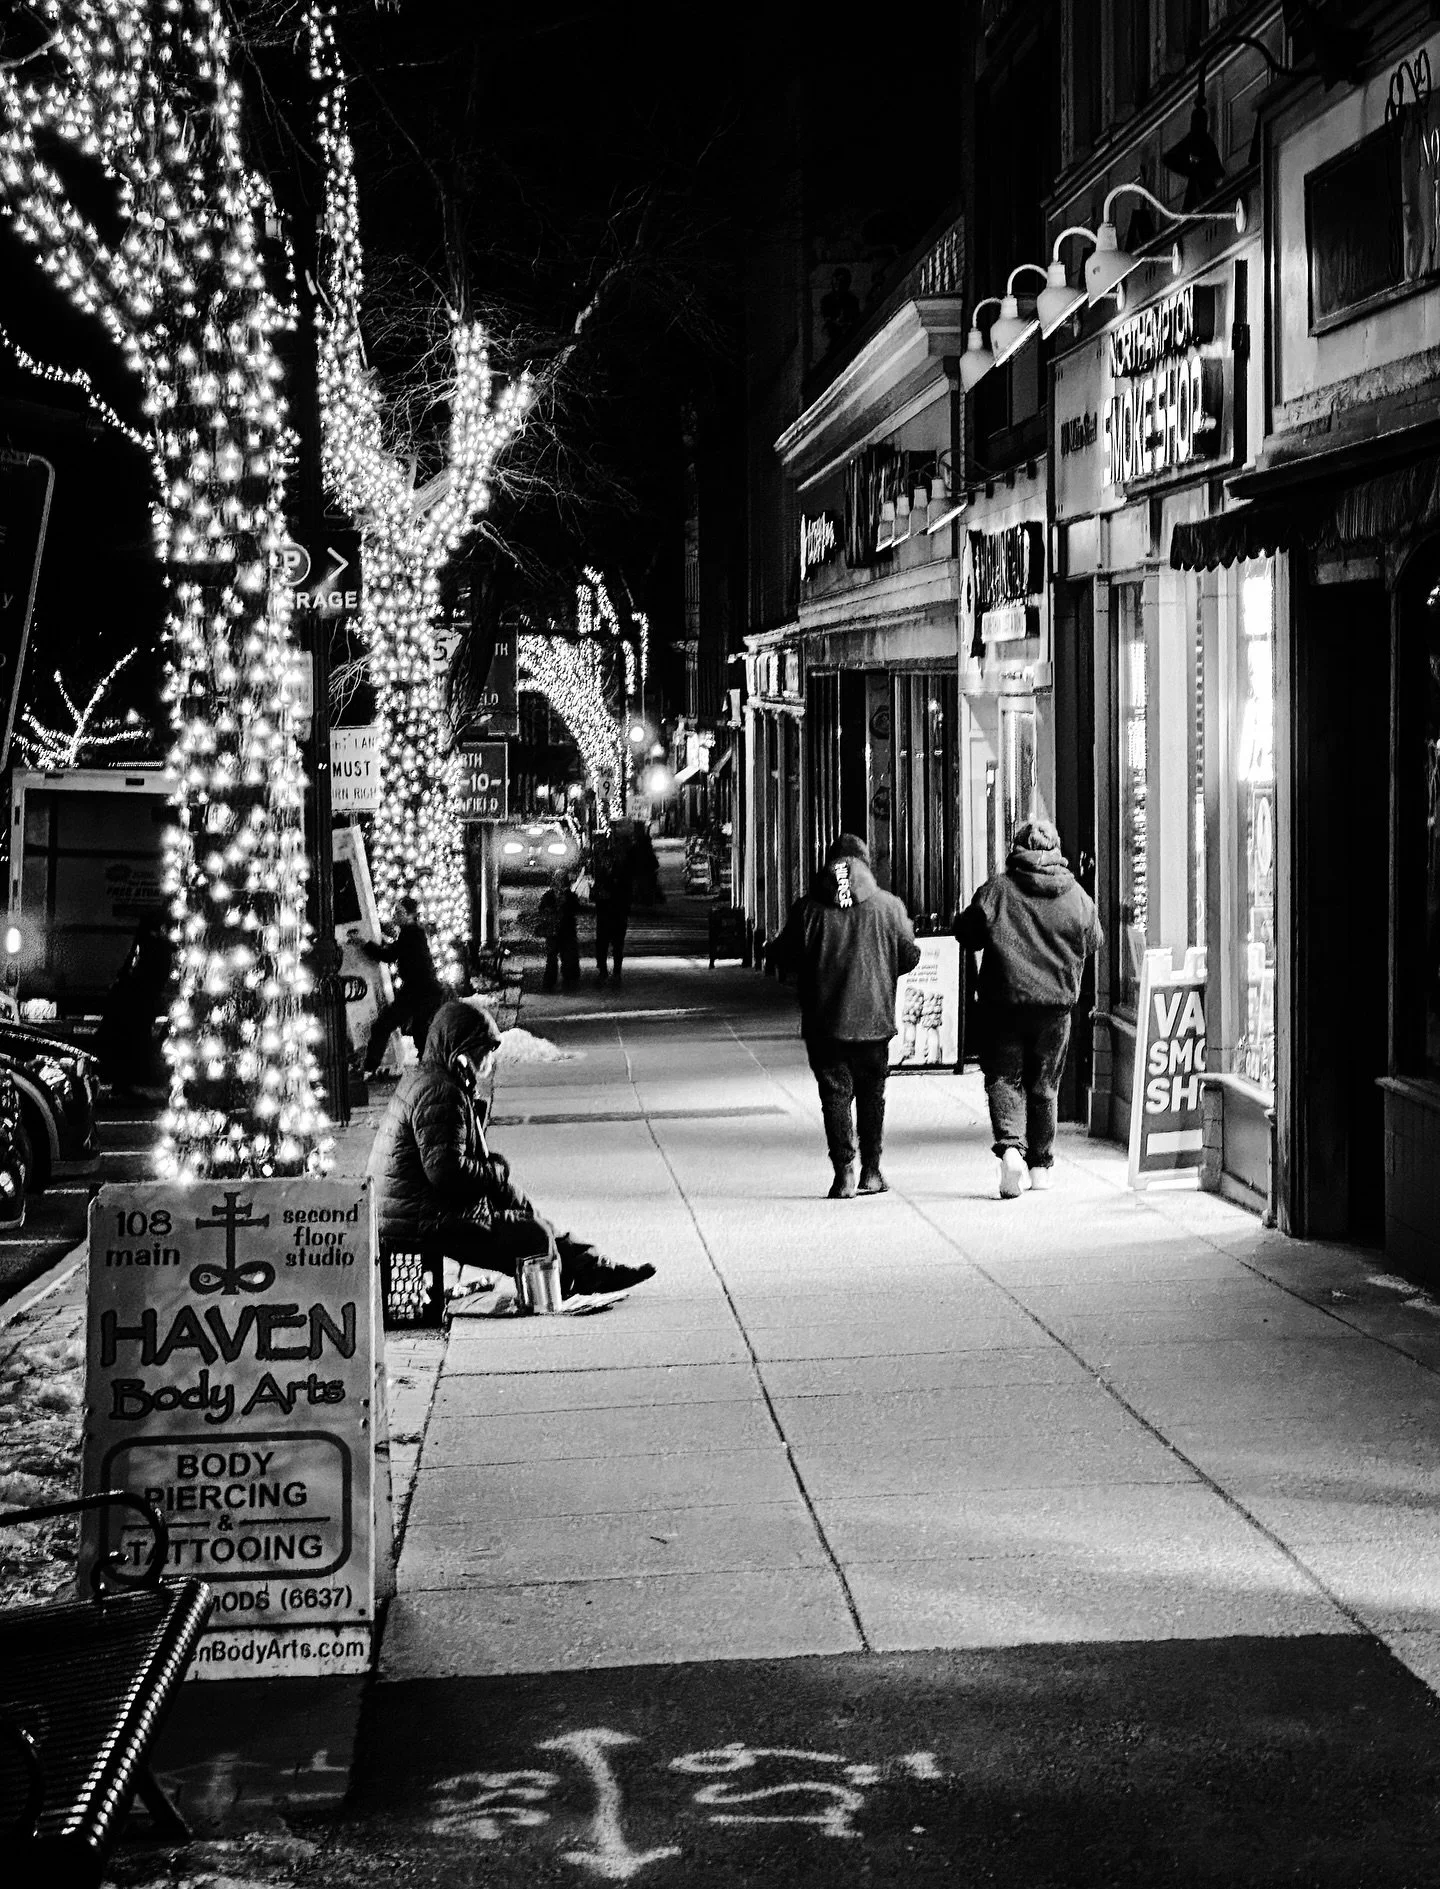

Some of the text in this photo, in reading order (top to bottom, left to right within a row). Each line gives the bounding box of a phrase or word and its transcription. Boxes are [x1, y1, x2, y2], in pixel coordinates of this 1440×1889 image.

[1103, 377, 1152, 487] SMOKE
[1155, 355, 1201, 470] SHOP
[332, 760, 371, 777] MUST
[1145, 1074, 1206, 1114] SH
[116, 1209, 172, 1237] 108
[282, 1203, 359, 1224] second
[293, 1226, 347, 1247] floor
[105, 1242, 181, 1267] main
[285, 1247, 355, 1267] studio
[100, 1301, 356, 1368] HAVEN
[109, 1368, 346, 1425] Body Arts
[177, 1451, 275, 1479] BODY
[144, 1481, 307, 1511] PIERCING
[217, 1514, 233, 1531] &
[126, 1534, 322, 1566] TTTOOING
[281, 1585, 352, 1611] (6637)
